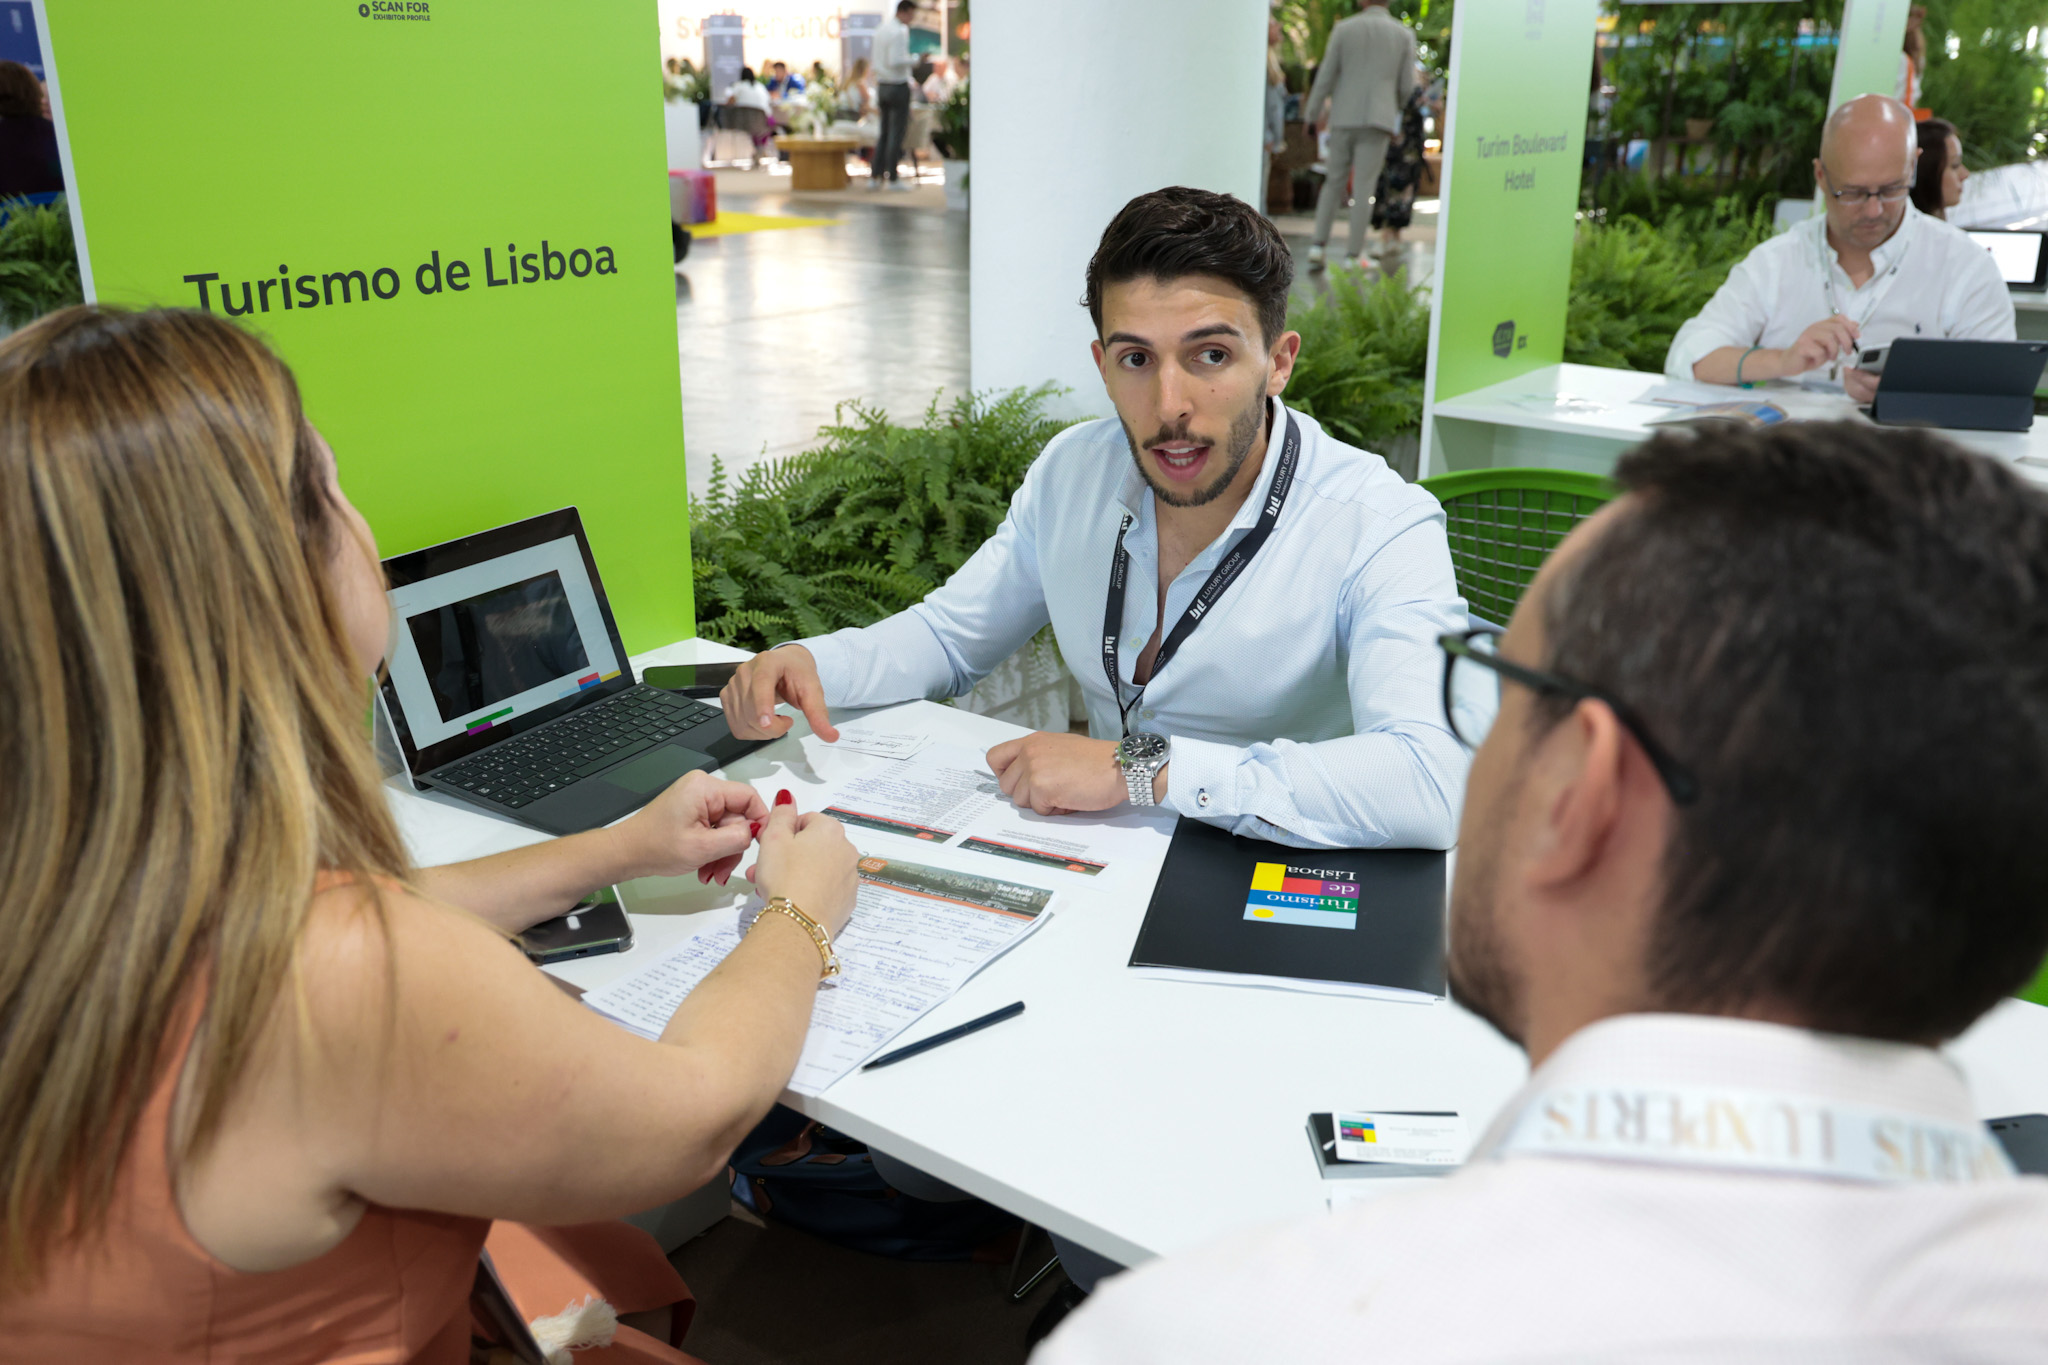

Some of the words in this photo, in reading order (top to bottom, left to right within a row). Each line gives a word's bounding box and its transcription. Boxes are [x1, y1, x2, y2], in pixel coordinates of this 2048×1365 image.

[372, 1, 404, 12] SCAN
[406, 2, 430, 13] FOR
[1476, 135, 1511, 159] Turim
[1512, 131, 1568, 156] Boulevard
[1504, 167, 1536, 191] Hotel
[183, 264, 401, 317] Turismo
[415, 250, 471, 295] de
[484, 240, 618, 287] Lisboa
[1274, 465, 1288, 494] LUXURY
[1283, 438, 1294, 465] GROUP
[1116, 563, 1125, 590] GROUP
[1202, 573, 1223, 600] LUXURY
[1221, 552, 1241, 576] GROUP
[1287, 866, 1357, 881] Lisboa
[1329, 884, 1355, 894] de
[1267, 894, 1356, 911] Turismo
